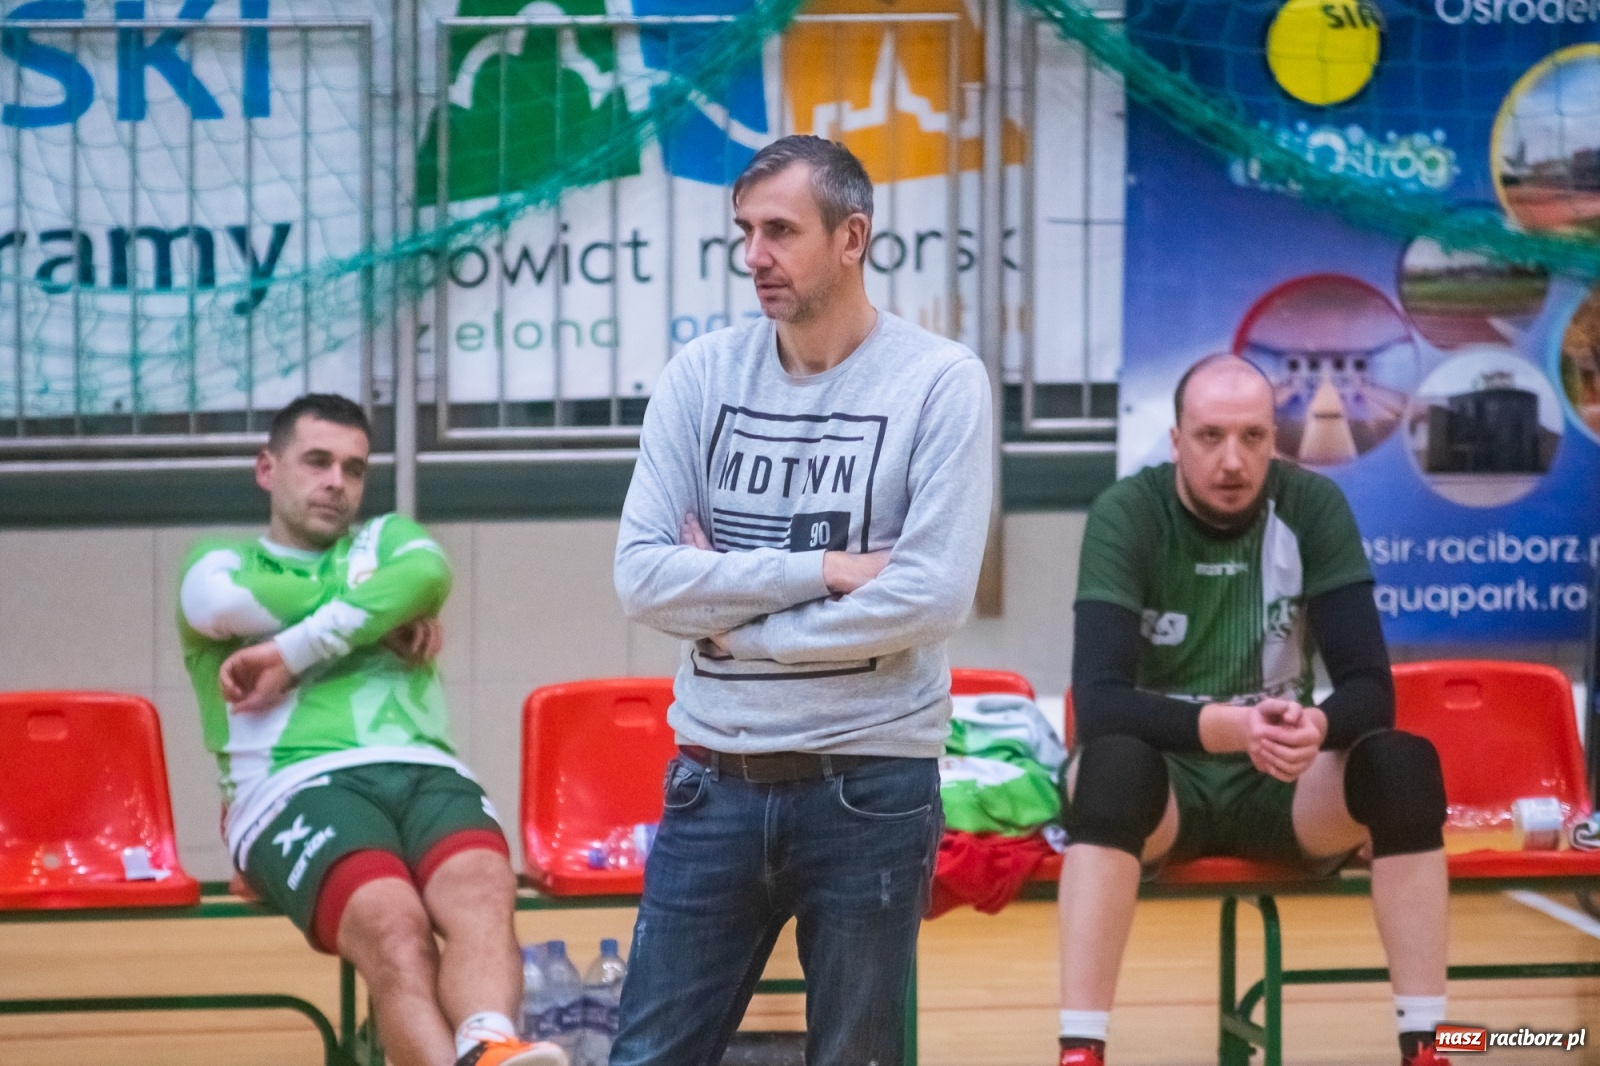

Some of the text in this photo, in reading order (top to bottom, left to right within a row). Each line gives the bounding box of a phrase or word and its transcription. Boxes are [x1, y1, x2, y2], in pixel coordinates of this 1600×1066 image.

[0, 0, 272, 128] SKI
[717, 450, 857, 498] MDTWN
[809, 521, 831, 548] 90
